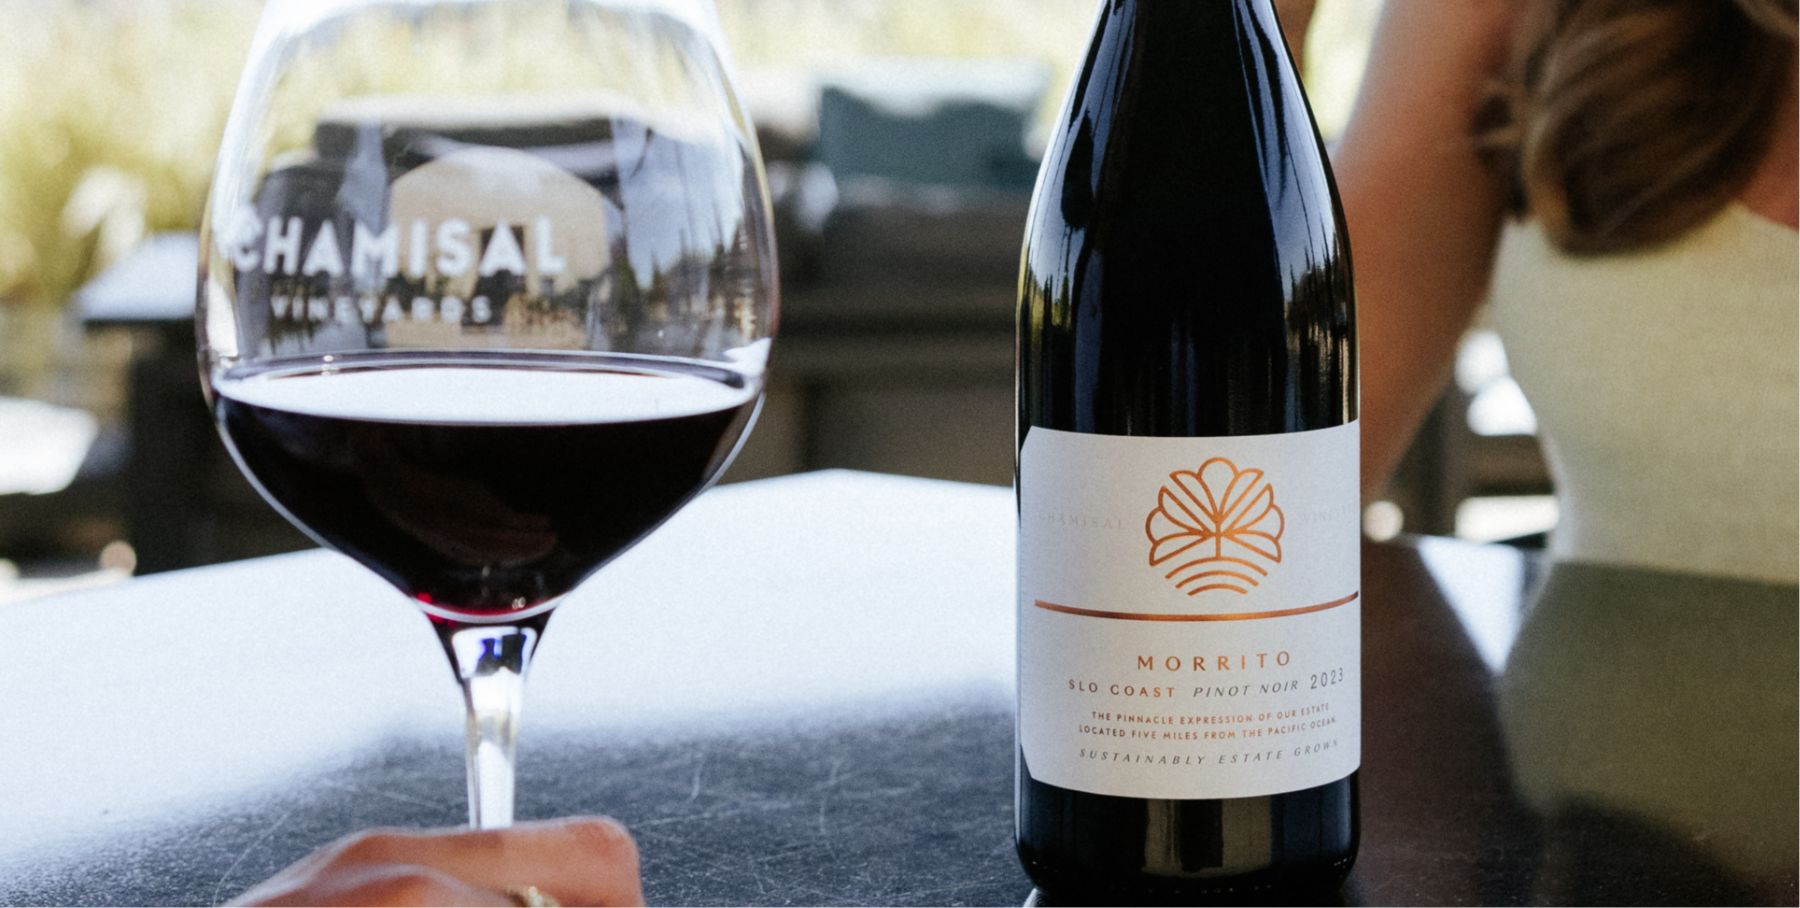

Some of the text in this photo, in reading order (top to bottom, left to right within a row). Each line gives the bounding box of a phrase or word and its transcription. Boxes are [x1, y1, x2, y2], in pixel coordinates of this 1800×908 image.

[232, 214, 566, 278] CHAMISAL
[270, 294, 493, 324] VINEYARDS
[1136, 651, 1291, 672] MORRITO
[1068, 667, 1344, 699] SLO COAST PINOT NOIR 2023
[1078, 715, 1337, 741] LOCATED FIVE MILES FROM THE PACIFIC OCEAN
[1091, 702, 1330, 726] THE PINNACLE EXPRESSION OF OUR ESTATE
[1078, 738, 1339, 766] SUSTAINABLY ESTATE GROWN
